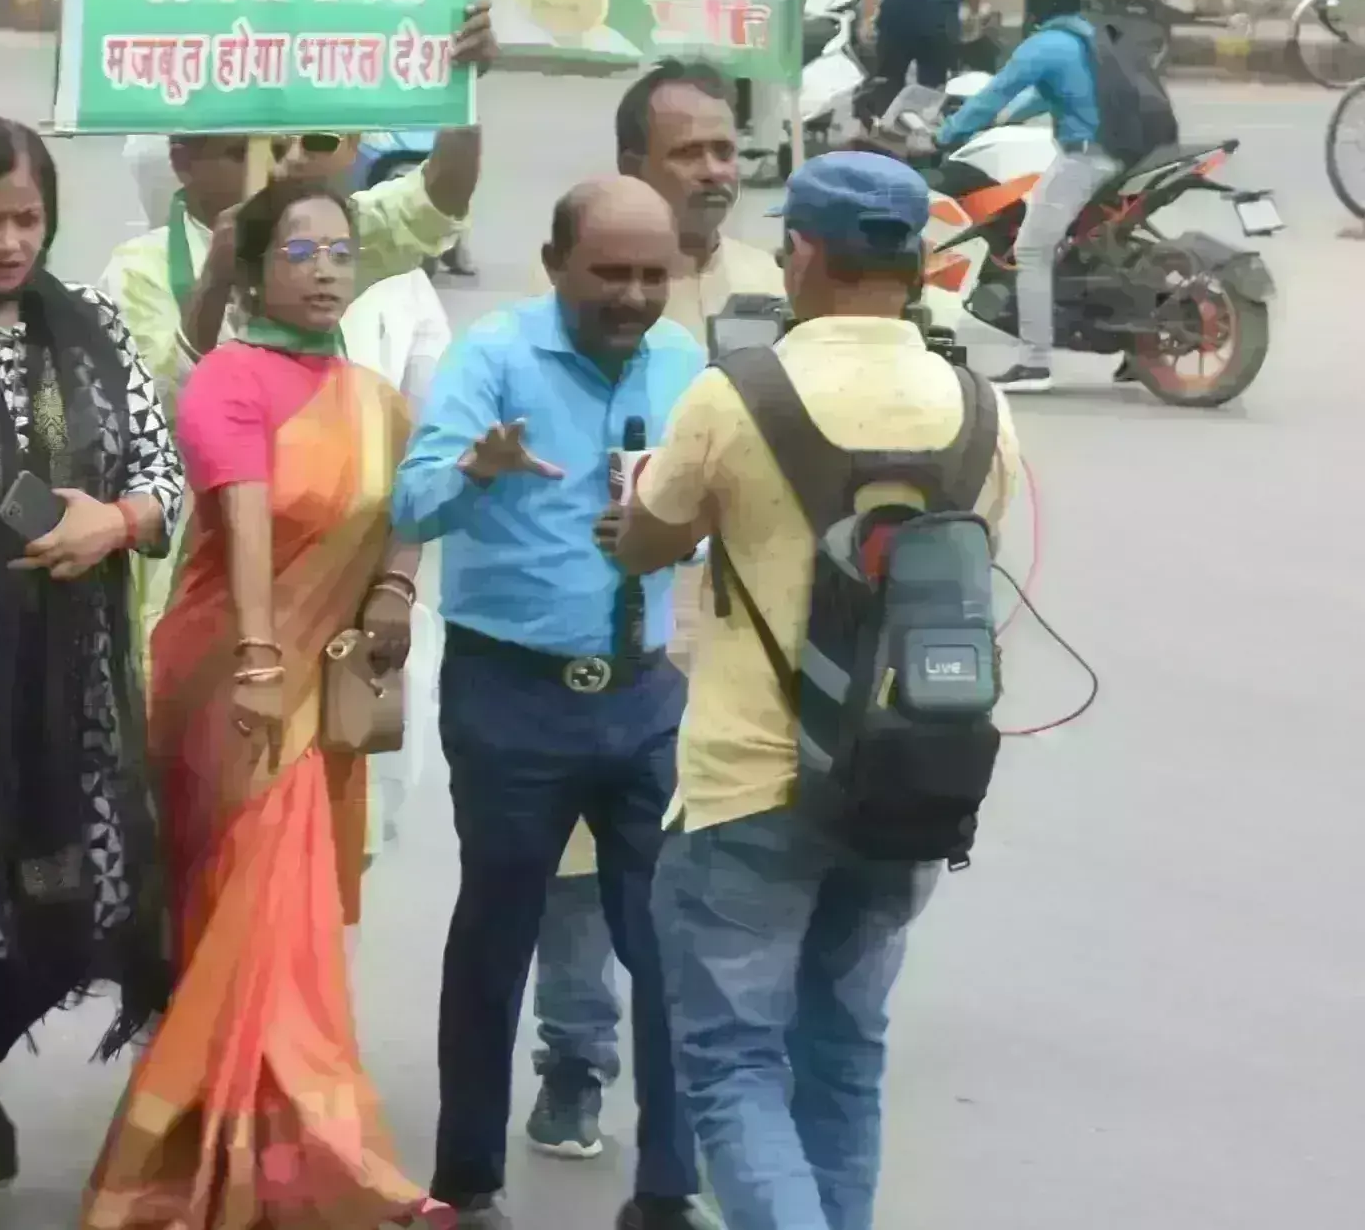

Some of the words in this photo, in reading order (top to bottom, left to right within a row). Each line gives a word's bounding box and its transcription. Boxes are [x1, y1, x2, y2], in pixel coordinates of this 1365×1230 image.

[105, 37, 205, 99] मजबूत
[217, 24, 286, 84] होगा
[297, 37, 381, 84] भारत
[392, 26, 449, 85] देश
